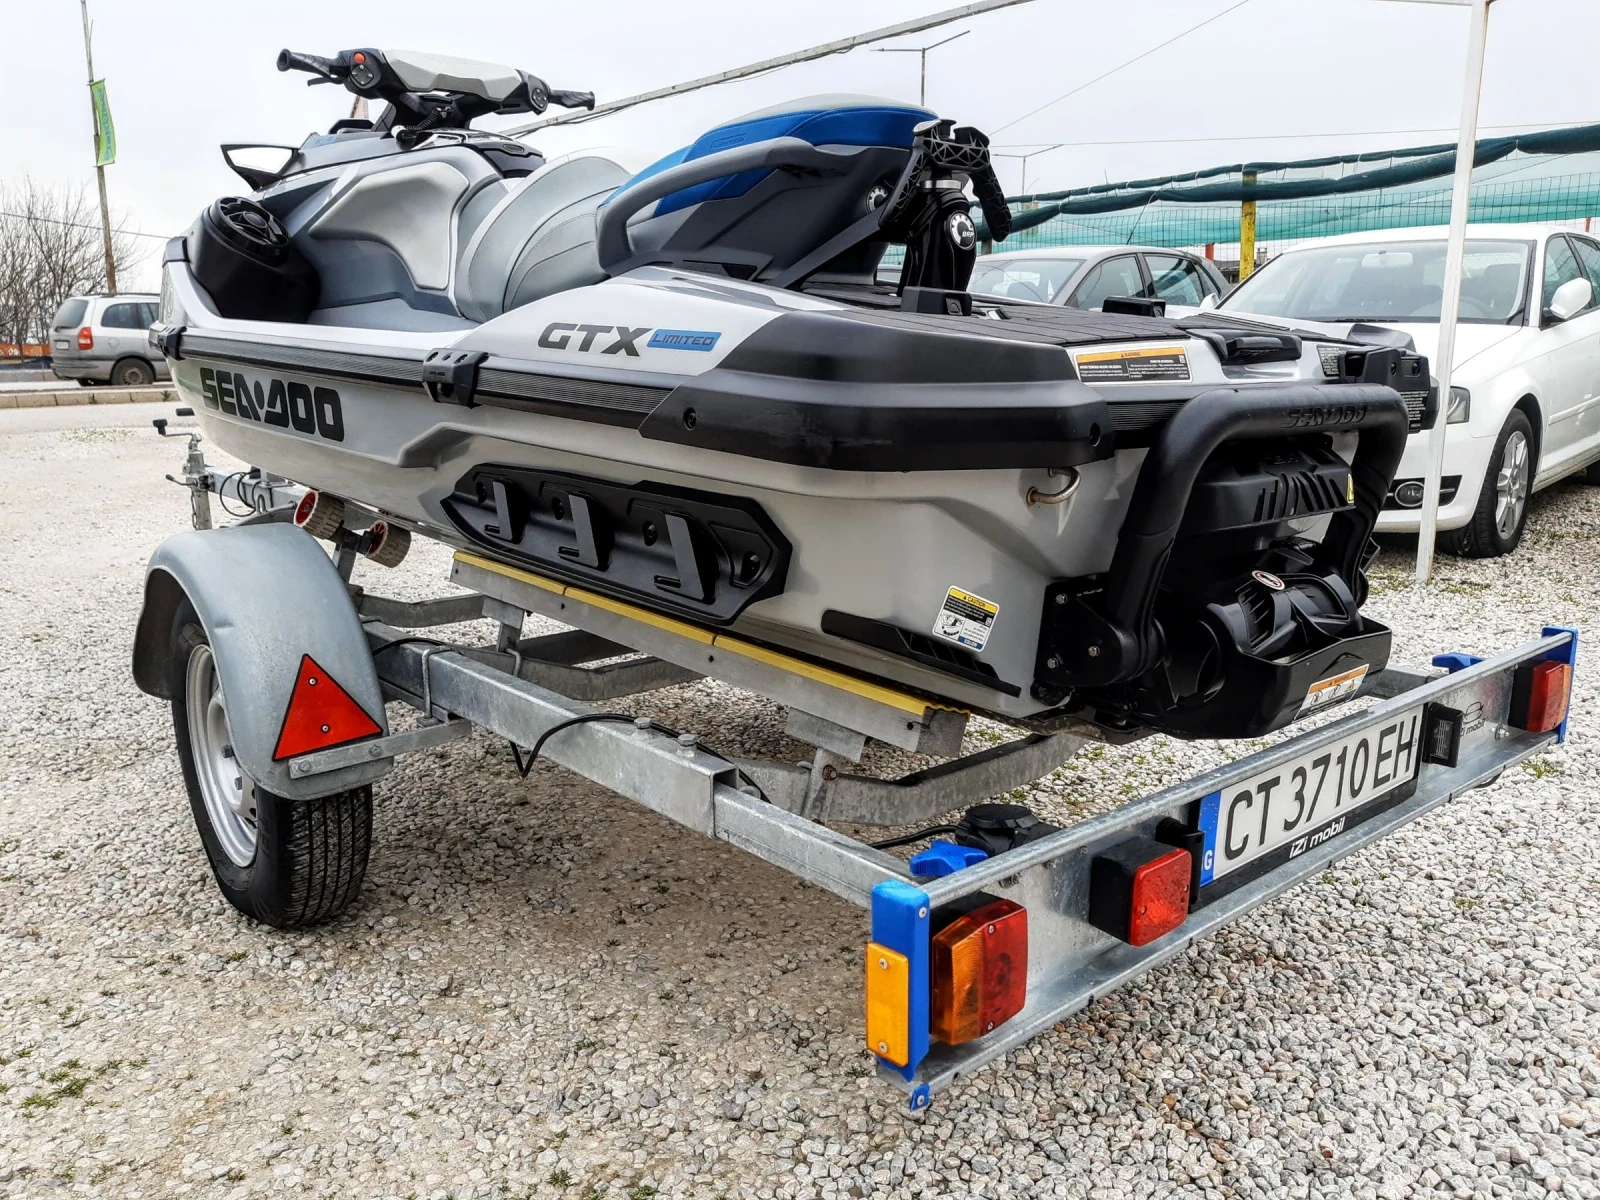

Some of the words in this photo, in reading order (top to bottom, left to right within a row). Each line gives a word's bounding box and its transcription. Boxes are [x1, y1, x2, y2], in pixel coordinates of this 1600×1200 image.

[538, 322, 653, 357] GTX
[652, 333, 716, 347] LIMITED
[967, 596, 986, 608] CAUTION
[1224, 775, 1281, 861] CT
[1283, 737, 1370, 832] 3710
[1373, 715, 1417, 790] EH
[1309, 816, 1346, 848] mobil
